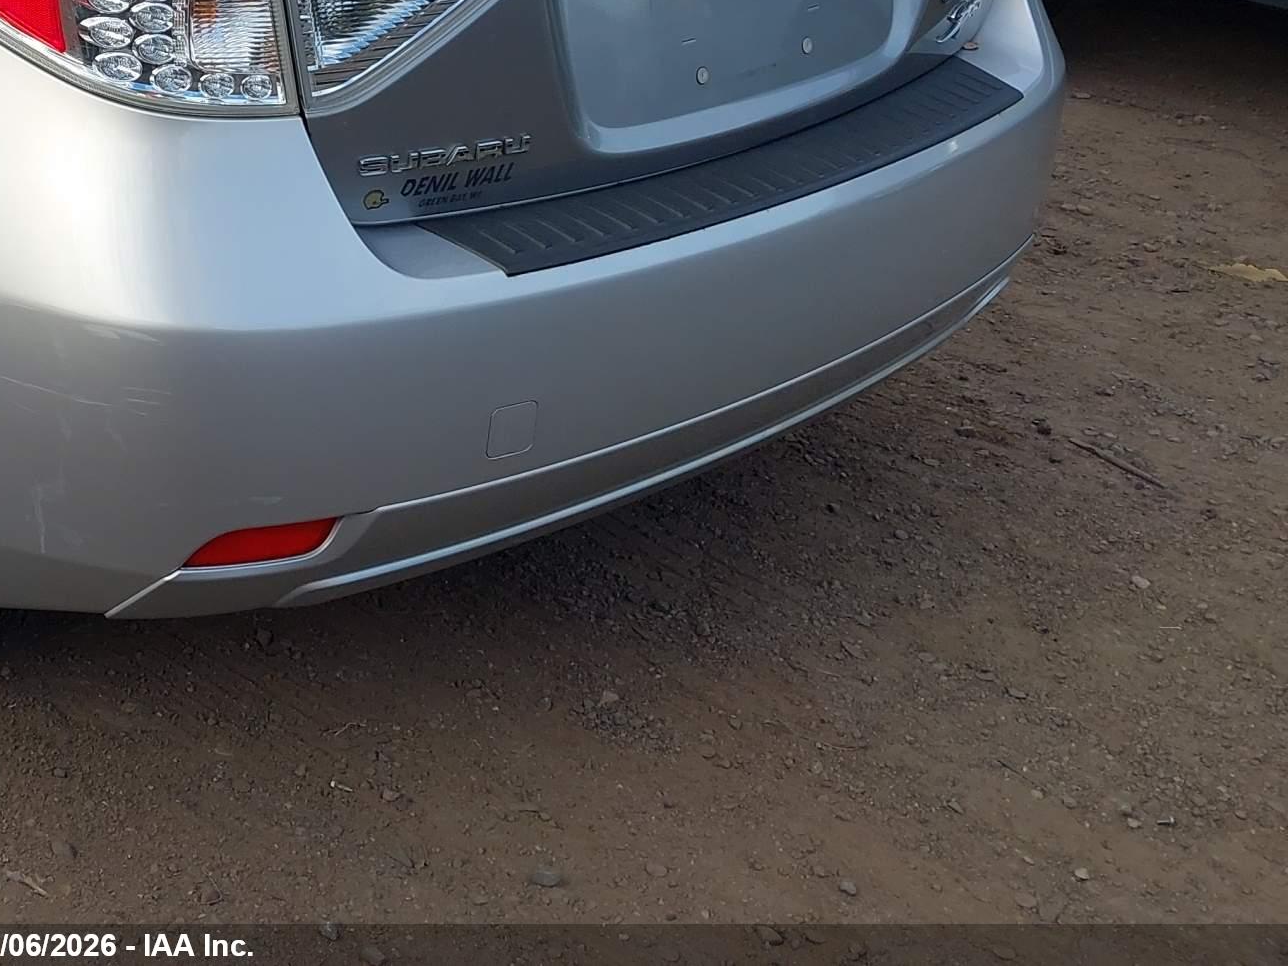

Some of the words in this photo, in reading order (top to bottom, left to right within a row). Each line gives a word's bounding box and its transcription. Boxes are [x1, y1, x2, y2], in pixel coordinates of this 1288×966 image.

[358, 133, 532, 177] SUBARU
[399, 172, 457, 197] DENIL
[464, 162, 515, 187] WALL
